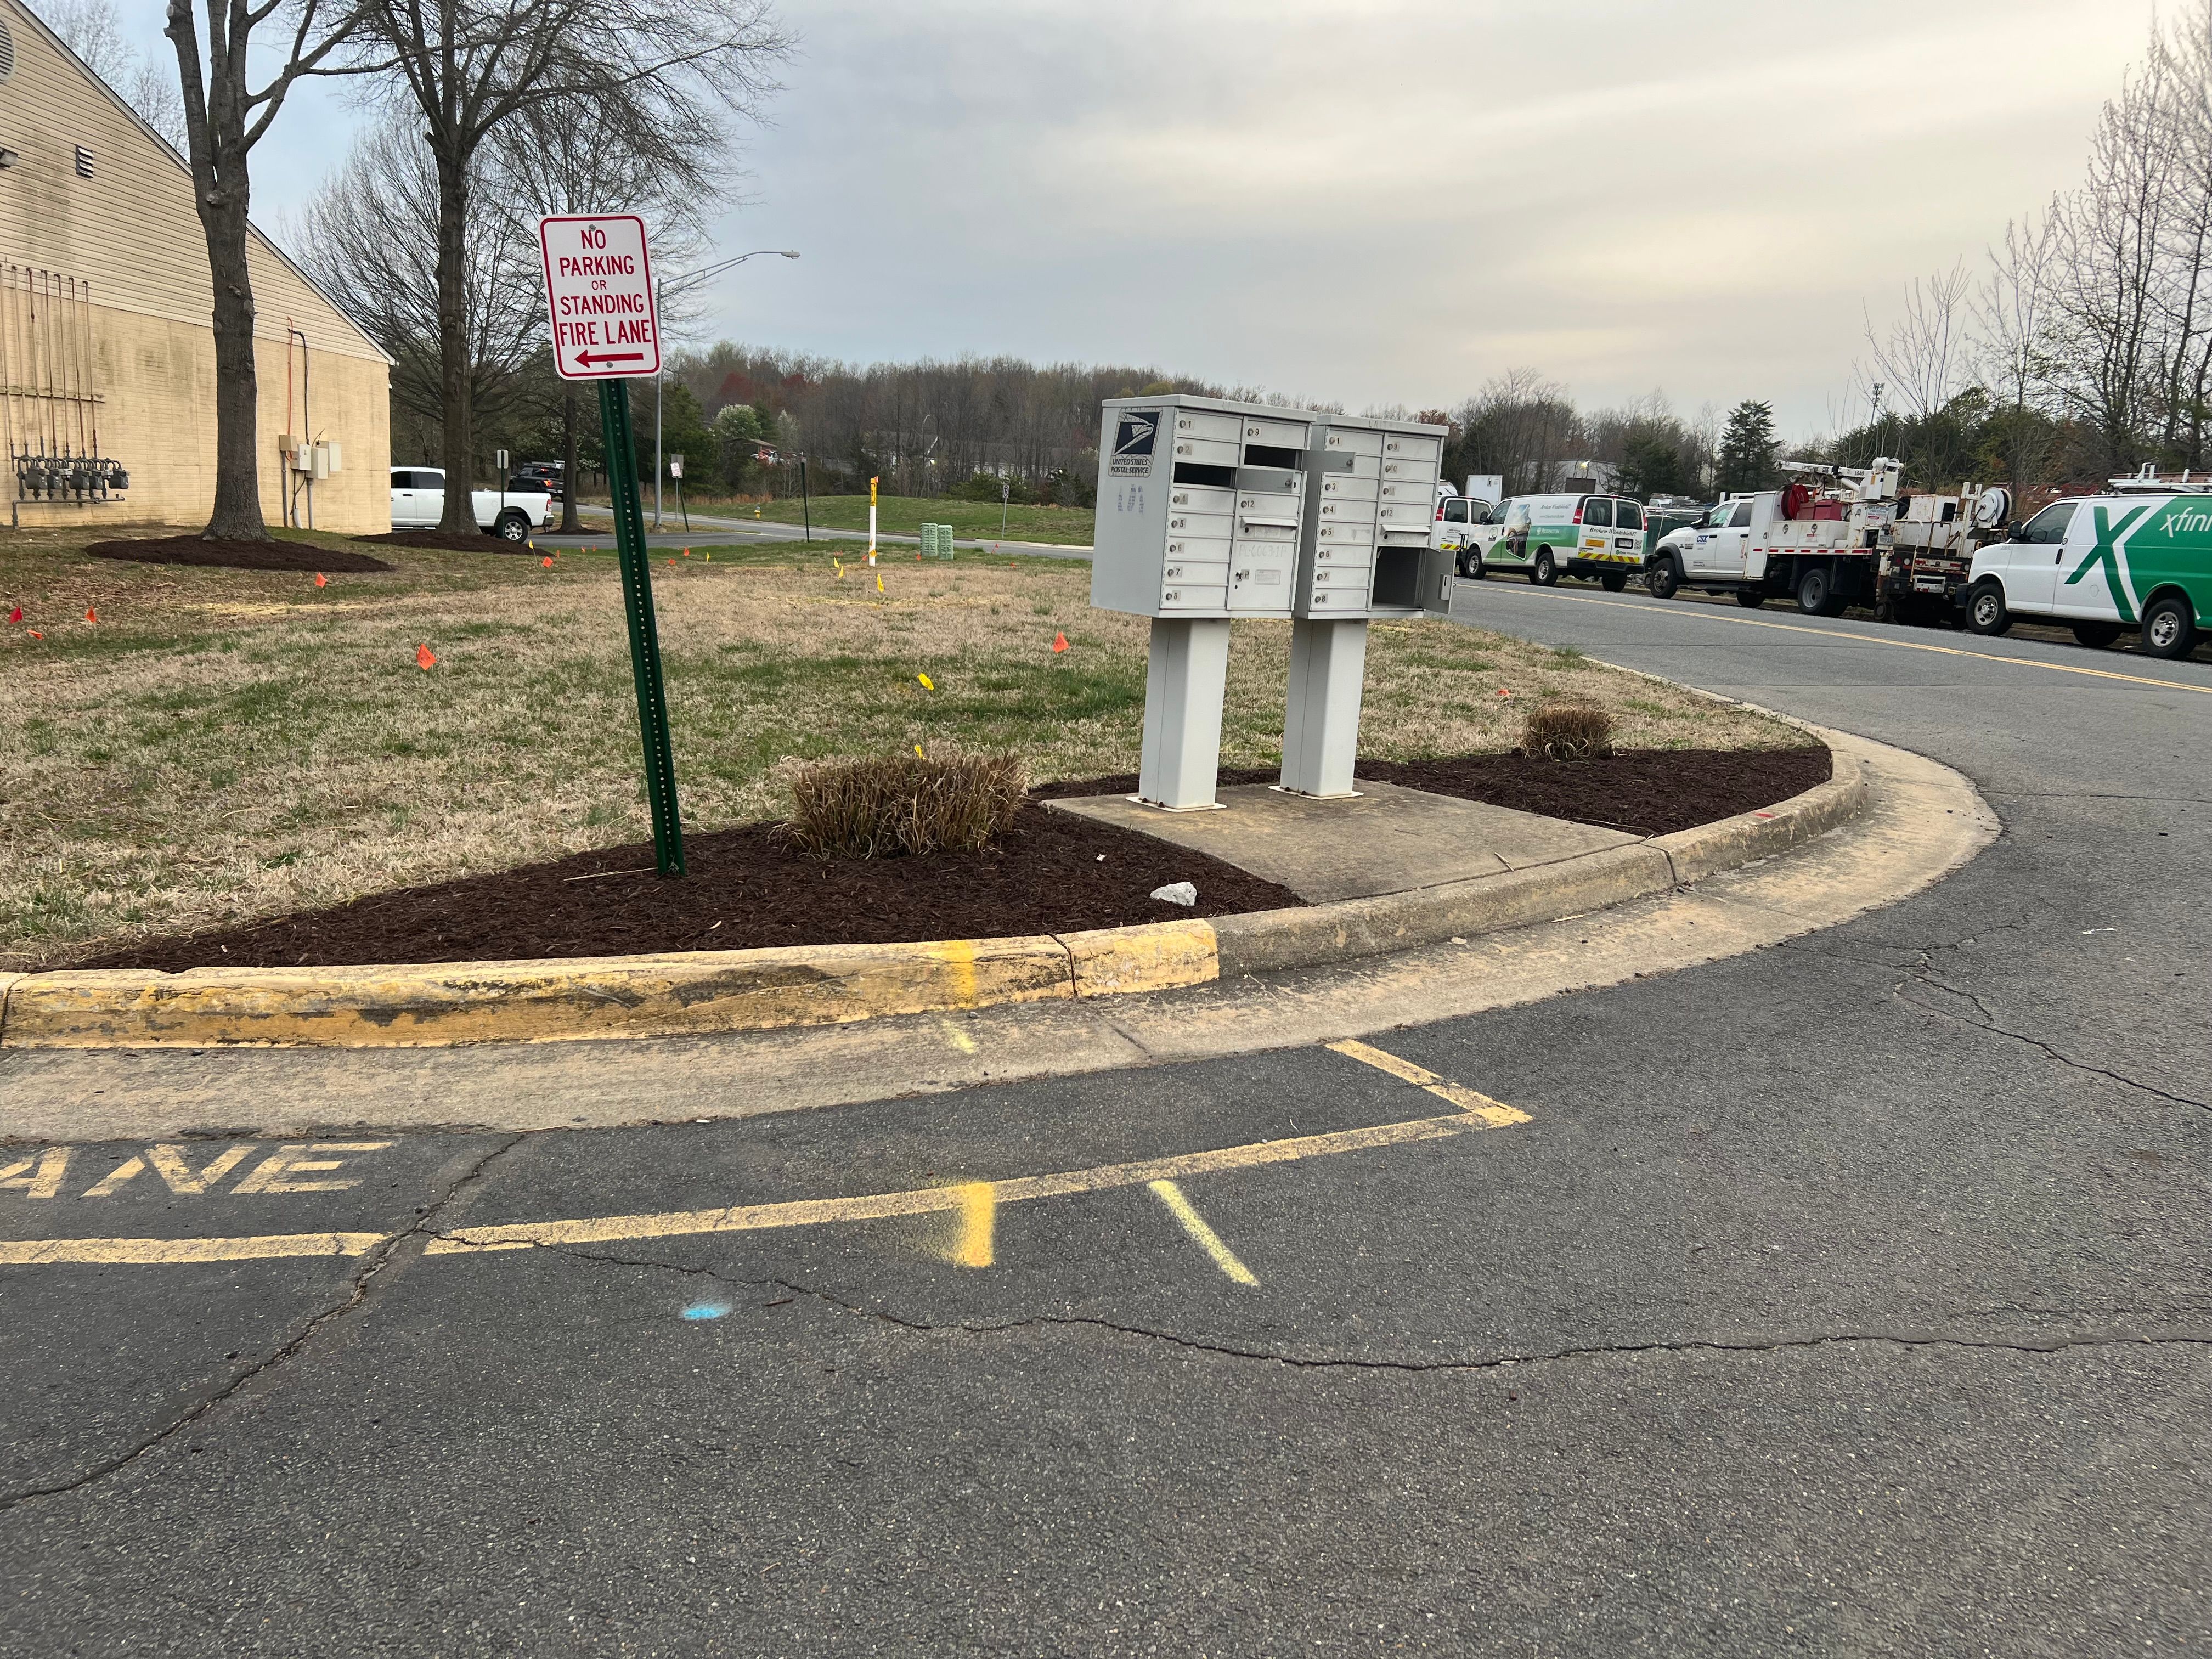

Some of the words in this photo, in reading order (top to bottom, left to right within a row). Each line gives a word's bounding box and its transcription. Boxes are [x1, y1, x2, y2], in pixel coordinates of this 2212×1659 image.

[580, 229, 606, 250] NO
[559, 255, 635, 276] PARKING
[591, 280, 607, 290] OR
[560, 294, 644, 315] STANDING
[558, 321, 599, 346] FIRE
[604, 319, 652, 345] LANE
[1188, 420, 1192, 428] 1
[1246, 500, 1254, 508] 12
[1180, 520, 1184, 528] 5
